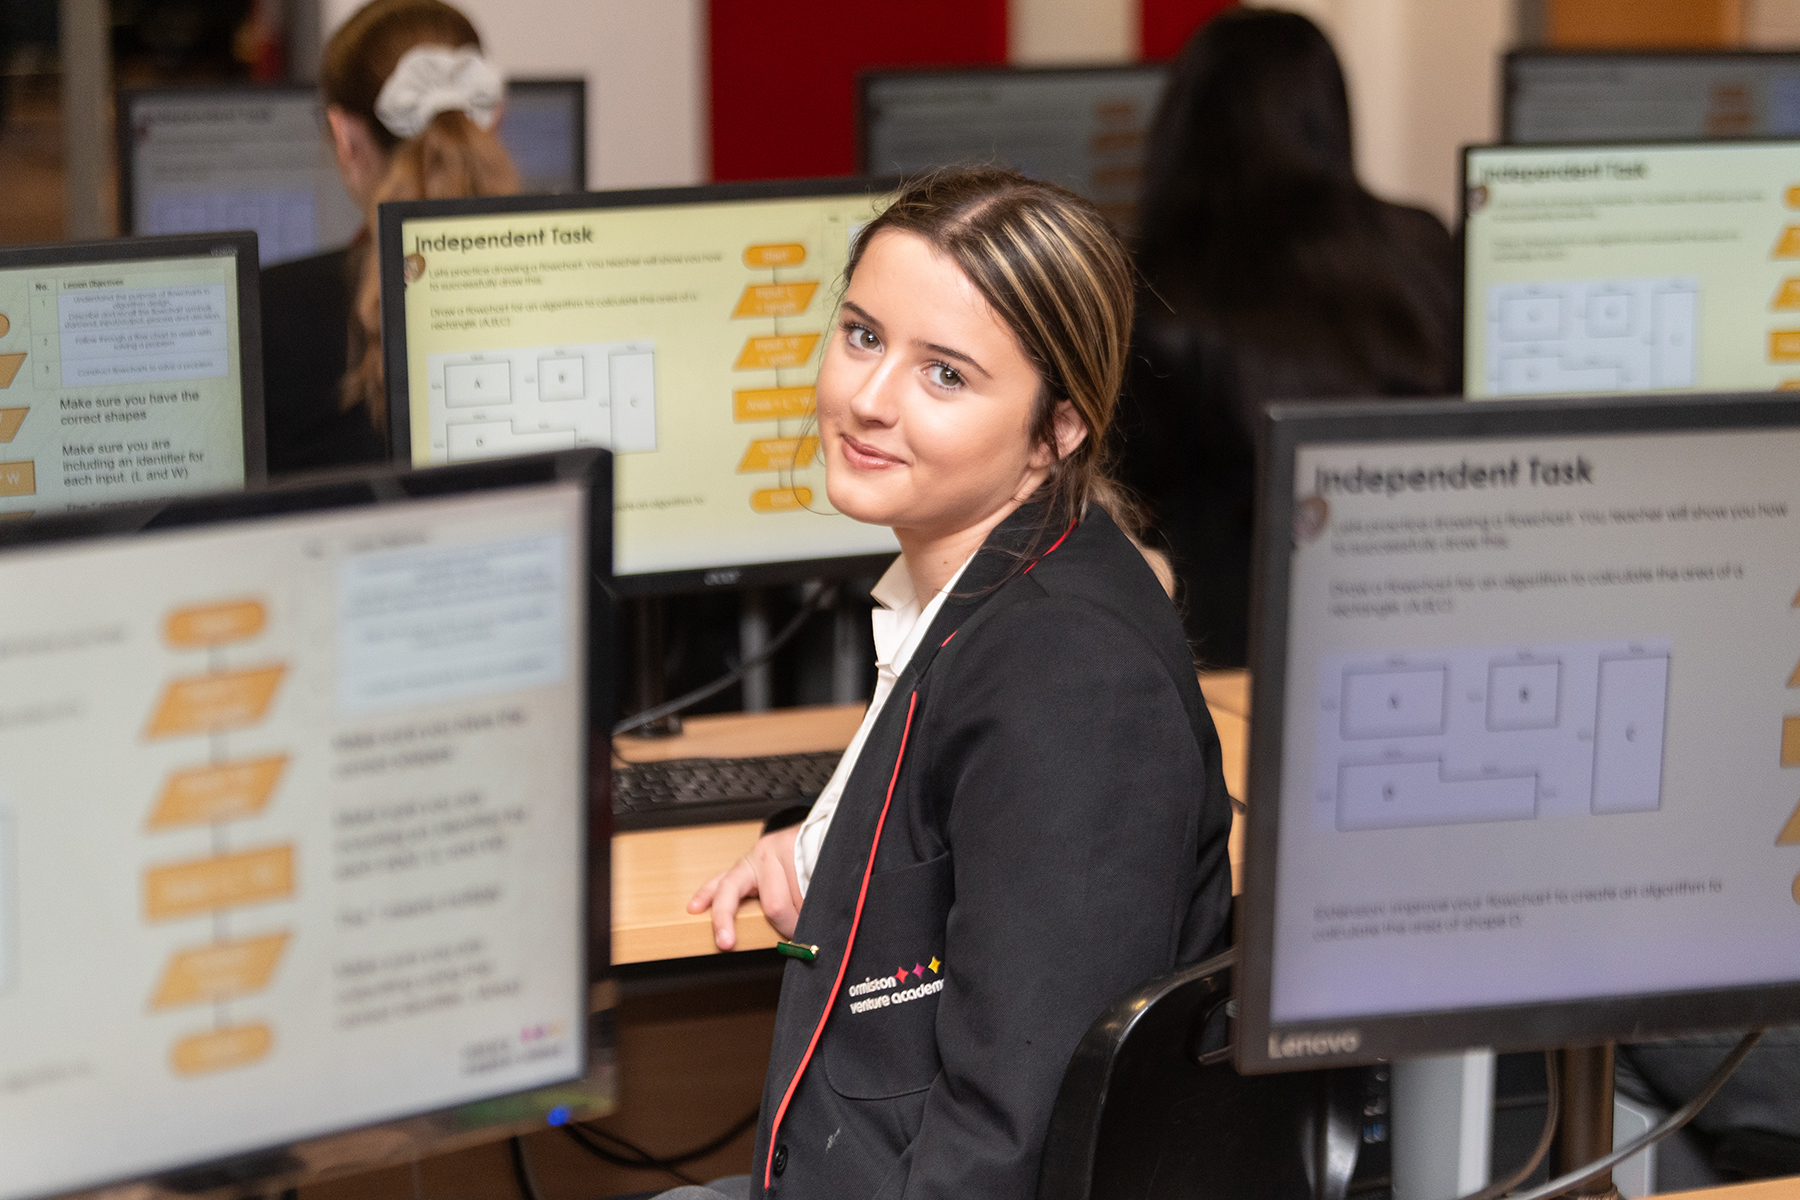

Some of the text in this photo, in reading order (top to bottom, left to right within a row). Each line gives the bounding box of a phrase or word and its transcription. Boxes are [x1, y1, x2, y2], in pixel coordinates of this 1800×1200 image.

[415, 226, 593, 253] Independent Task
[59, 390, 200, 410] Make sure you have the
[60, 409, 147, 426] correct shapes
[62, 440, 170, 456] Make sure you are
[62, 451, 205, 475] including an identifier for
[6, 473, 20, 485] W
[63, 474, 92, 487] each
[146, 469, 168, 481] and
[1315, 456, 1593, 498] Independent Task
[848, 976, 897, 997] ormiston
[849, 978, 945, 1014] venture academ
[1268, 1030, 1360, 1059] Lenovo
